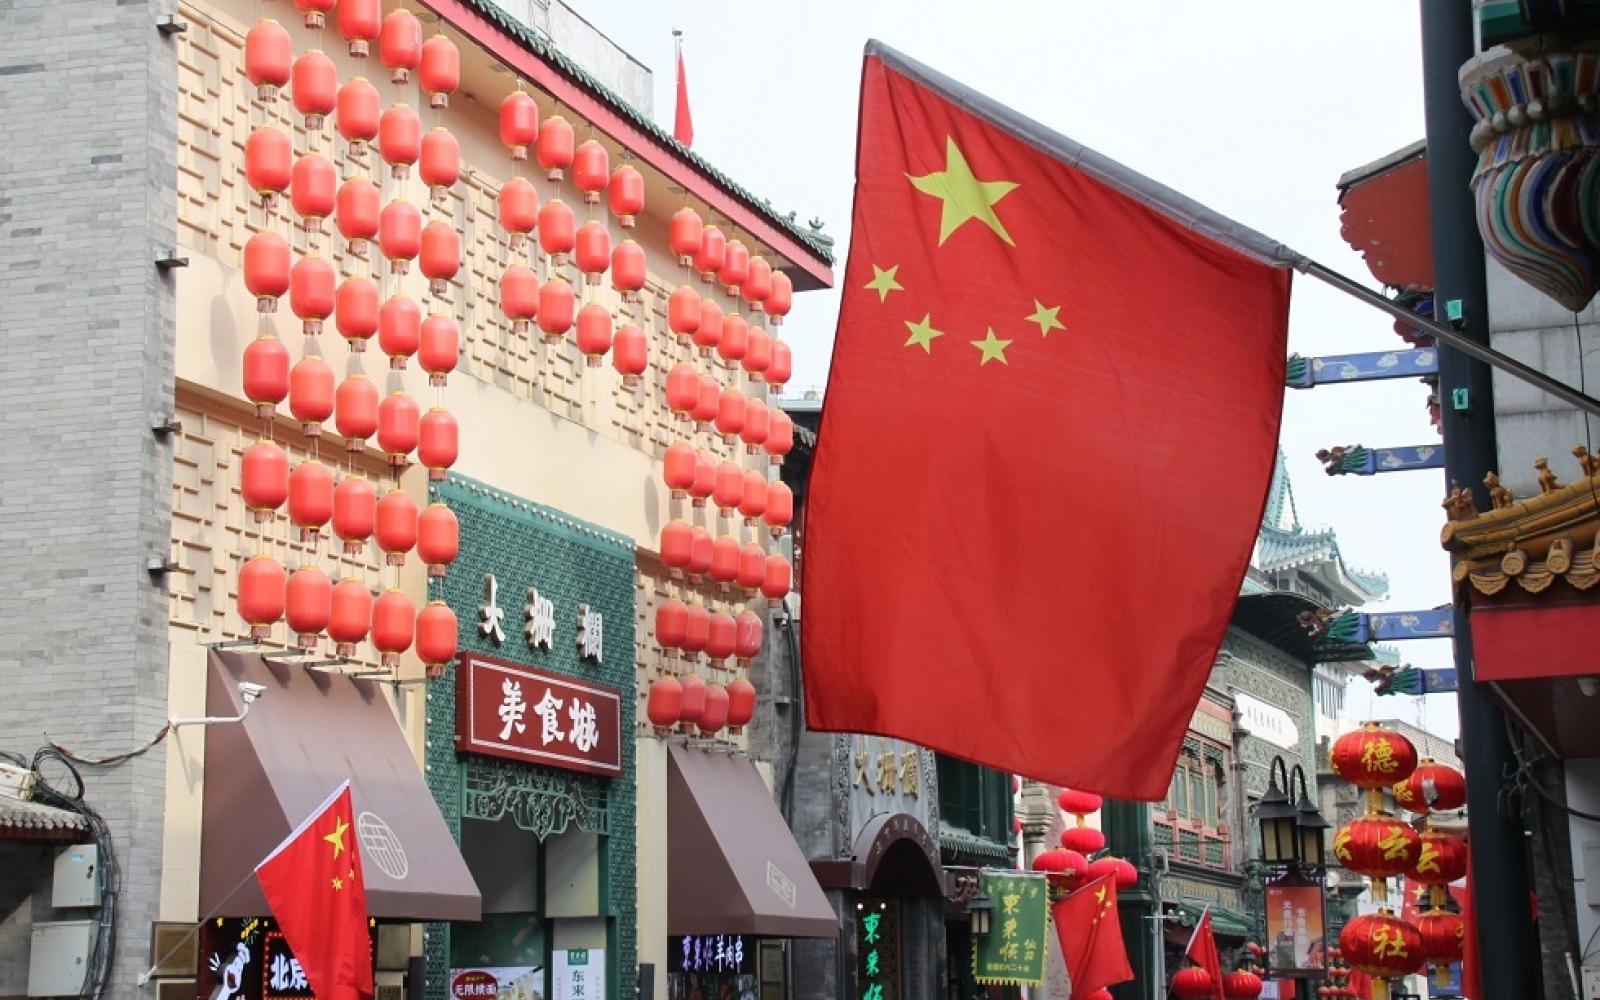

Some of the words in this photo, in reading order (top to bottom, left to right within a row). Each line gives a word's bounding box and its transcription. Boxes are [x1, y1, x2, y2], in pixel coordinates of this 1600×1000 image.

[498, 678, 599, 752] 美食城
[1362, 738, 1399, 773] 德
[1378, 826, 1412, 861] 云
[1373, 924, 1408, 960] 社
